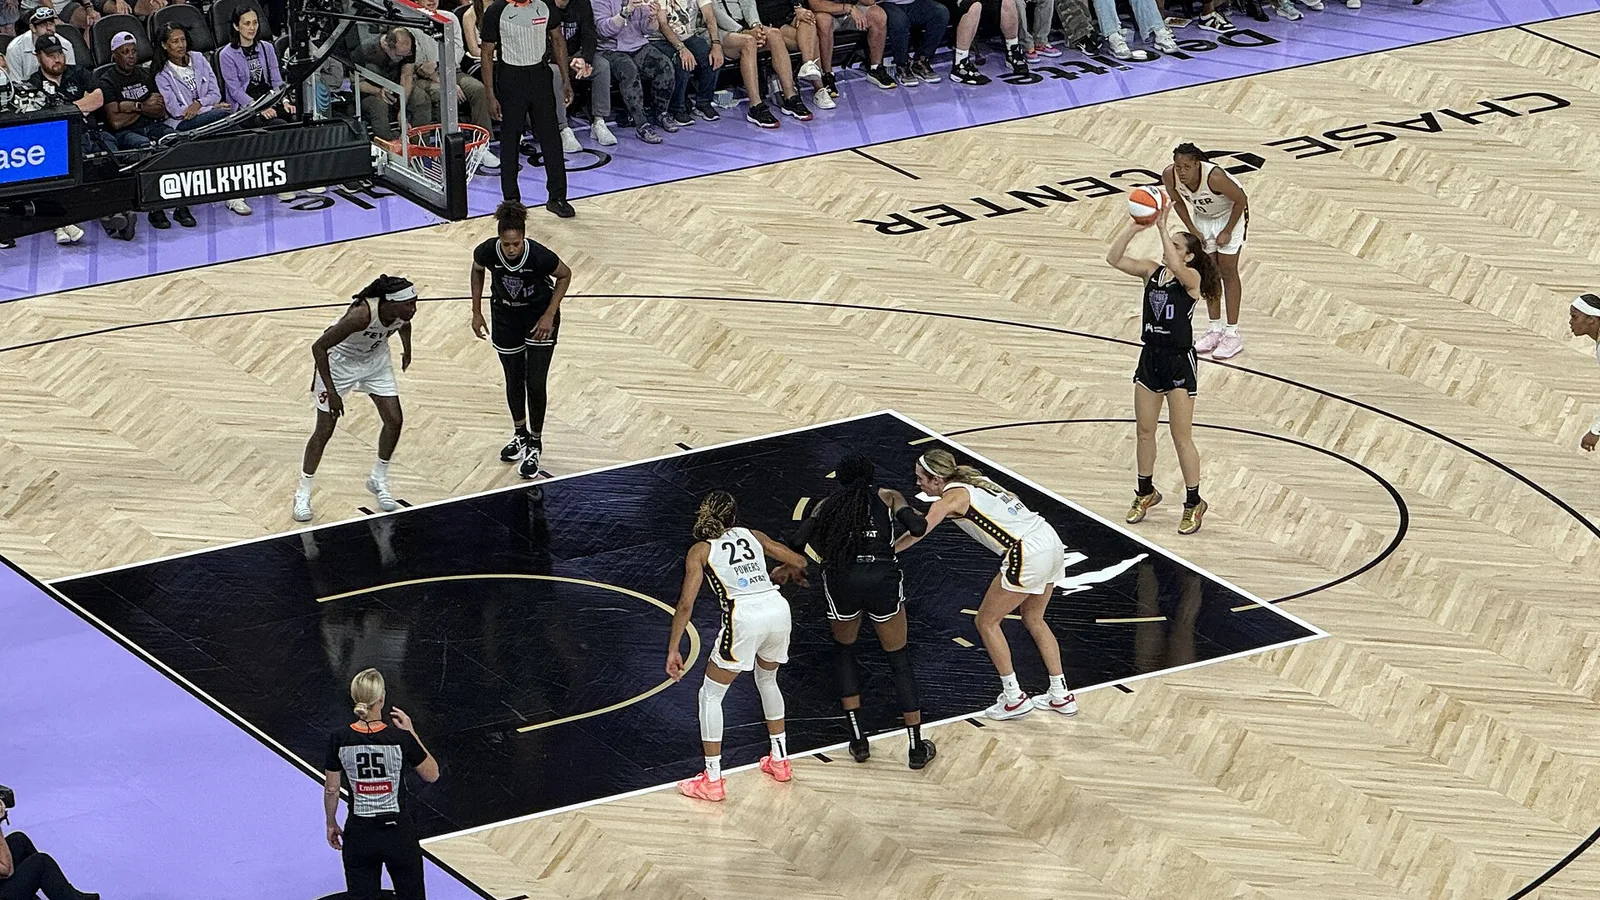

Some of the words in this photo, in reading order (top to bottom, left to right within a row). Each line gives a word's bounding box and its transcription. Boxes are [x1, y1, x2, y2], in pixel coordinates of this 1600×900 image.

[1261, 92, 1571, 160] CHASE
[159, 159, 287, 200] @VALKYRIES
[853, 168, 1163, 235] CENTER
[721, 538, 756, 566] 23
[733, 562, 761, 576] POWERS
[356, 752, 387, 779] 25
